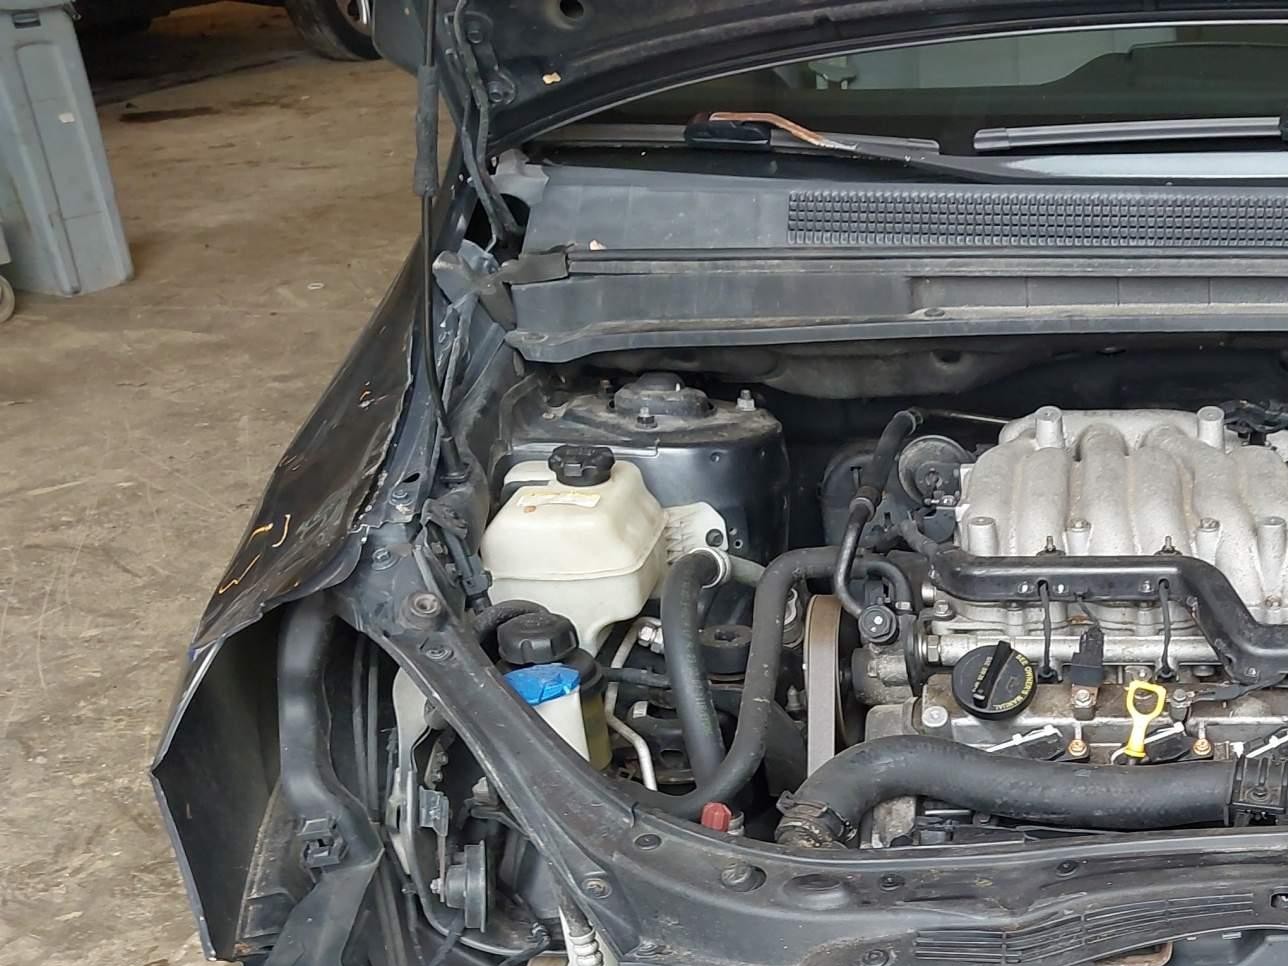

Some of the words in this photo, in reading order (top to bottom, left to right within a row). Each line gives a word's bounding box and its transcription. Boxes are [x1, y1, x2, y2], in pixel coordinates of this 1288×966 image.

[1016, 654, 1029, 667] SEE
[1021, 666, 1034, 695] OWNER'S
[992, 695, 1024, 711] MANUAL
